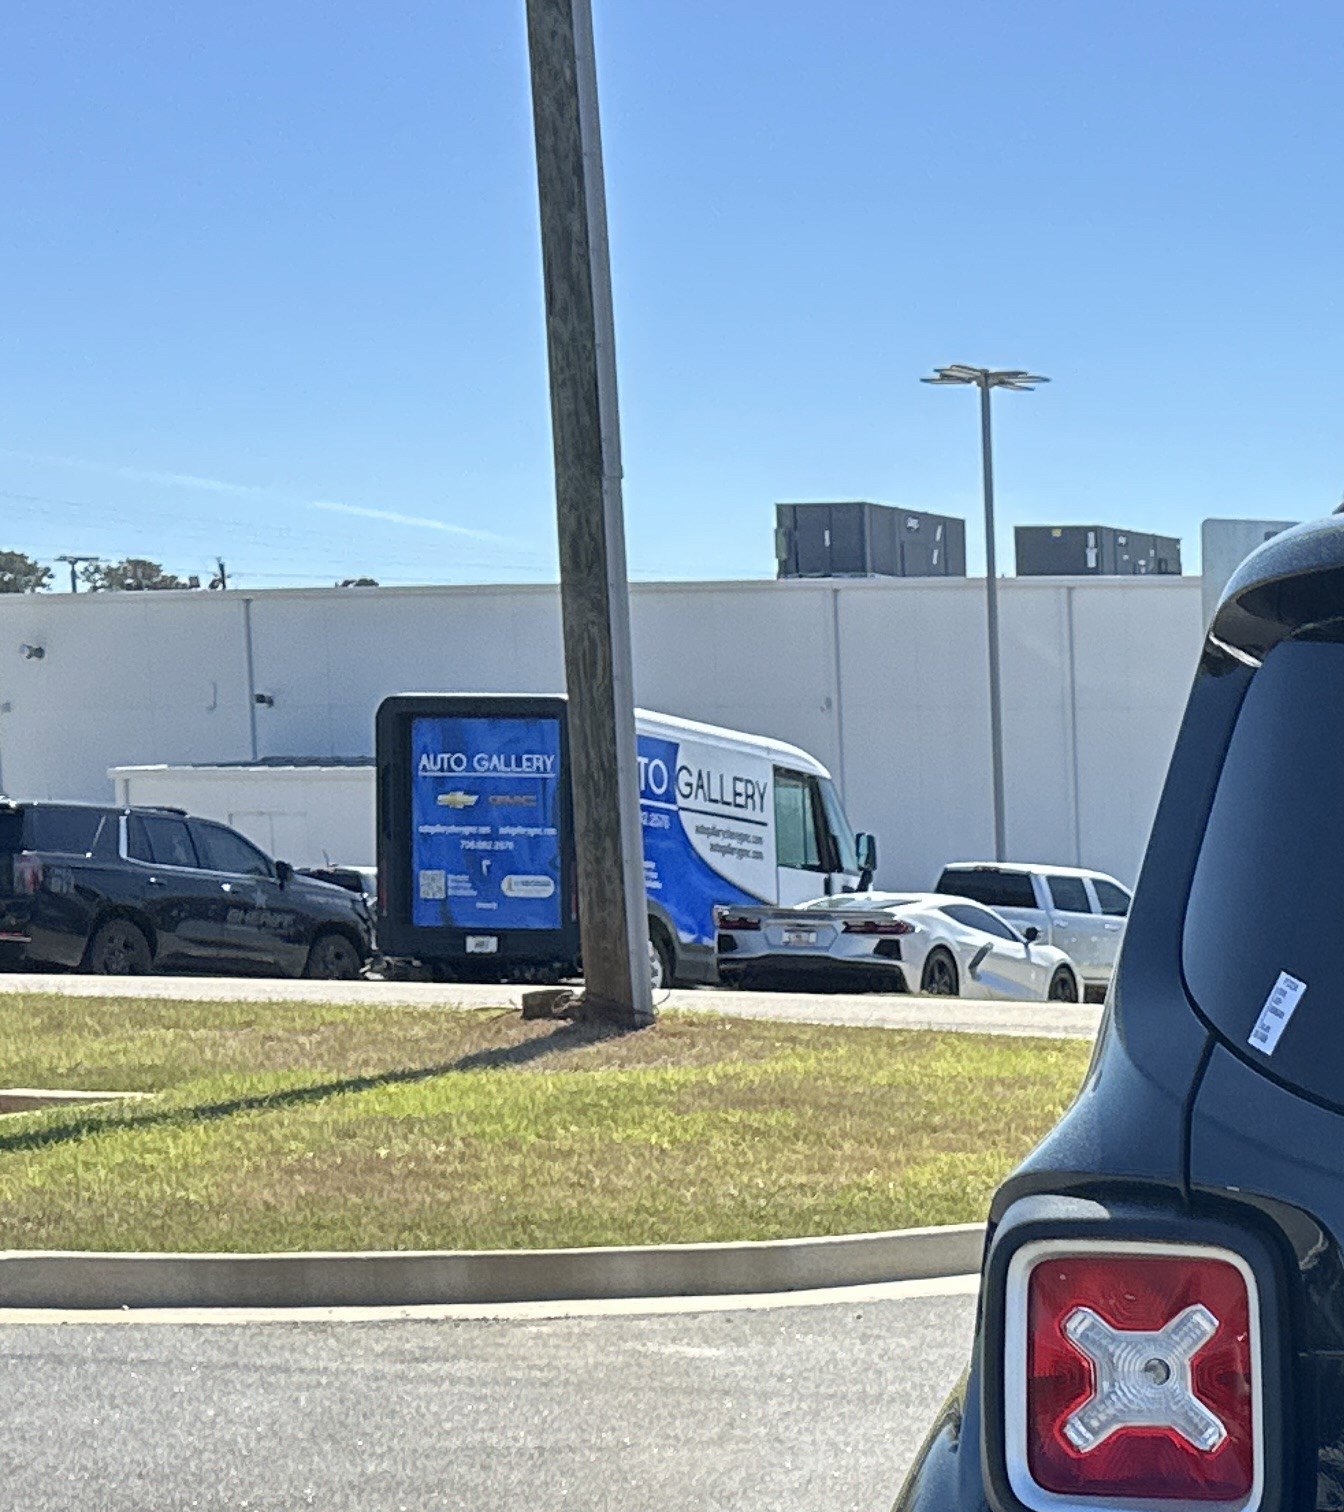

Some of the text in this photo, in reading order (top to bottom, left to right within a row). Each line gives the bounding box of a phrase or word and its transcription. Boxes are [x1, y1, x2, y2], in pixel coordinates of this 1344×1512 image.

[418, 753, 556, 773] AUTO GALLERY
[676, 764, 768, 813] GALLERY
